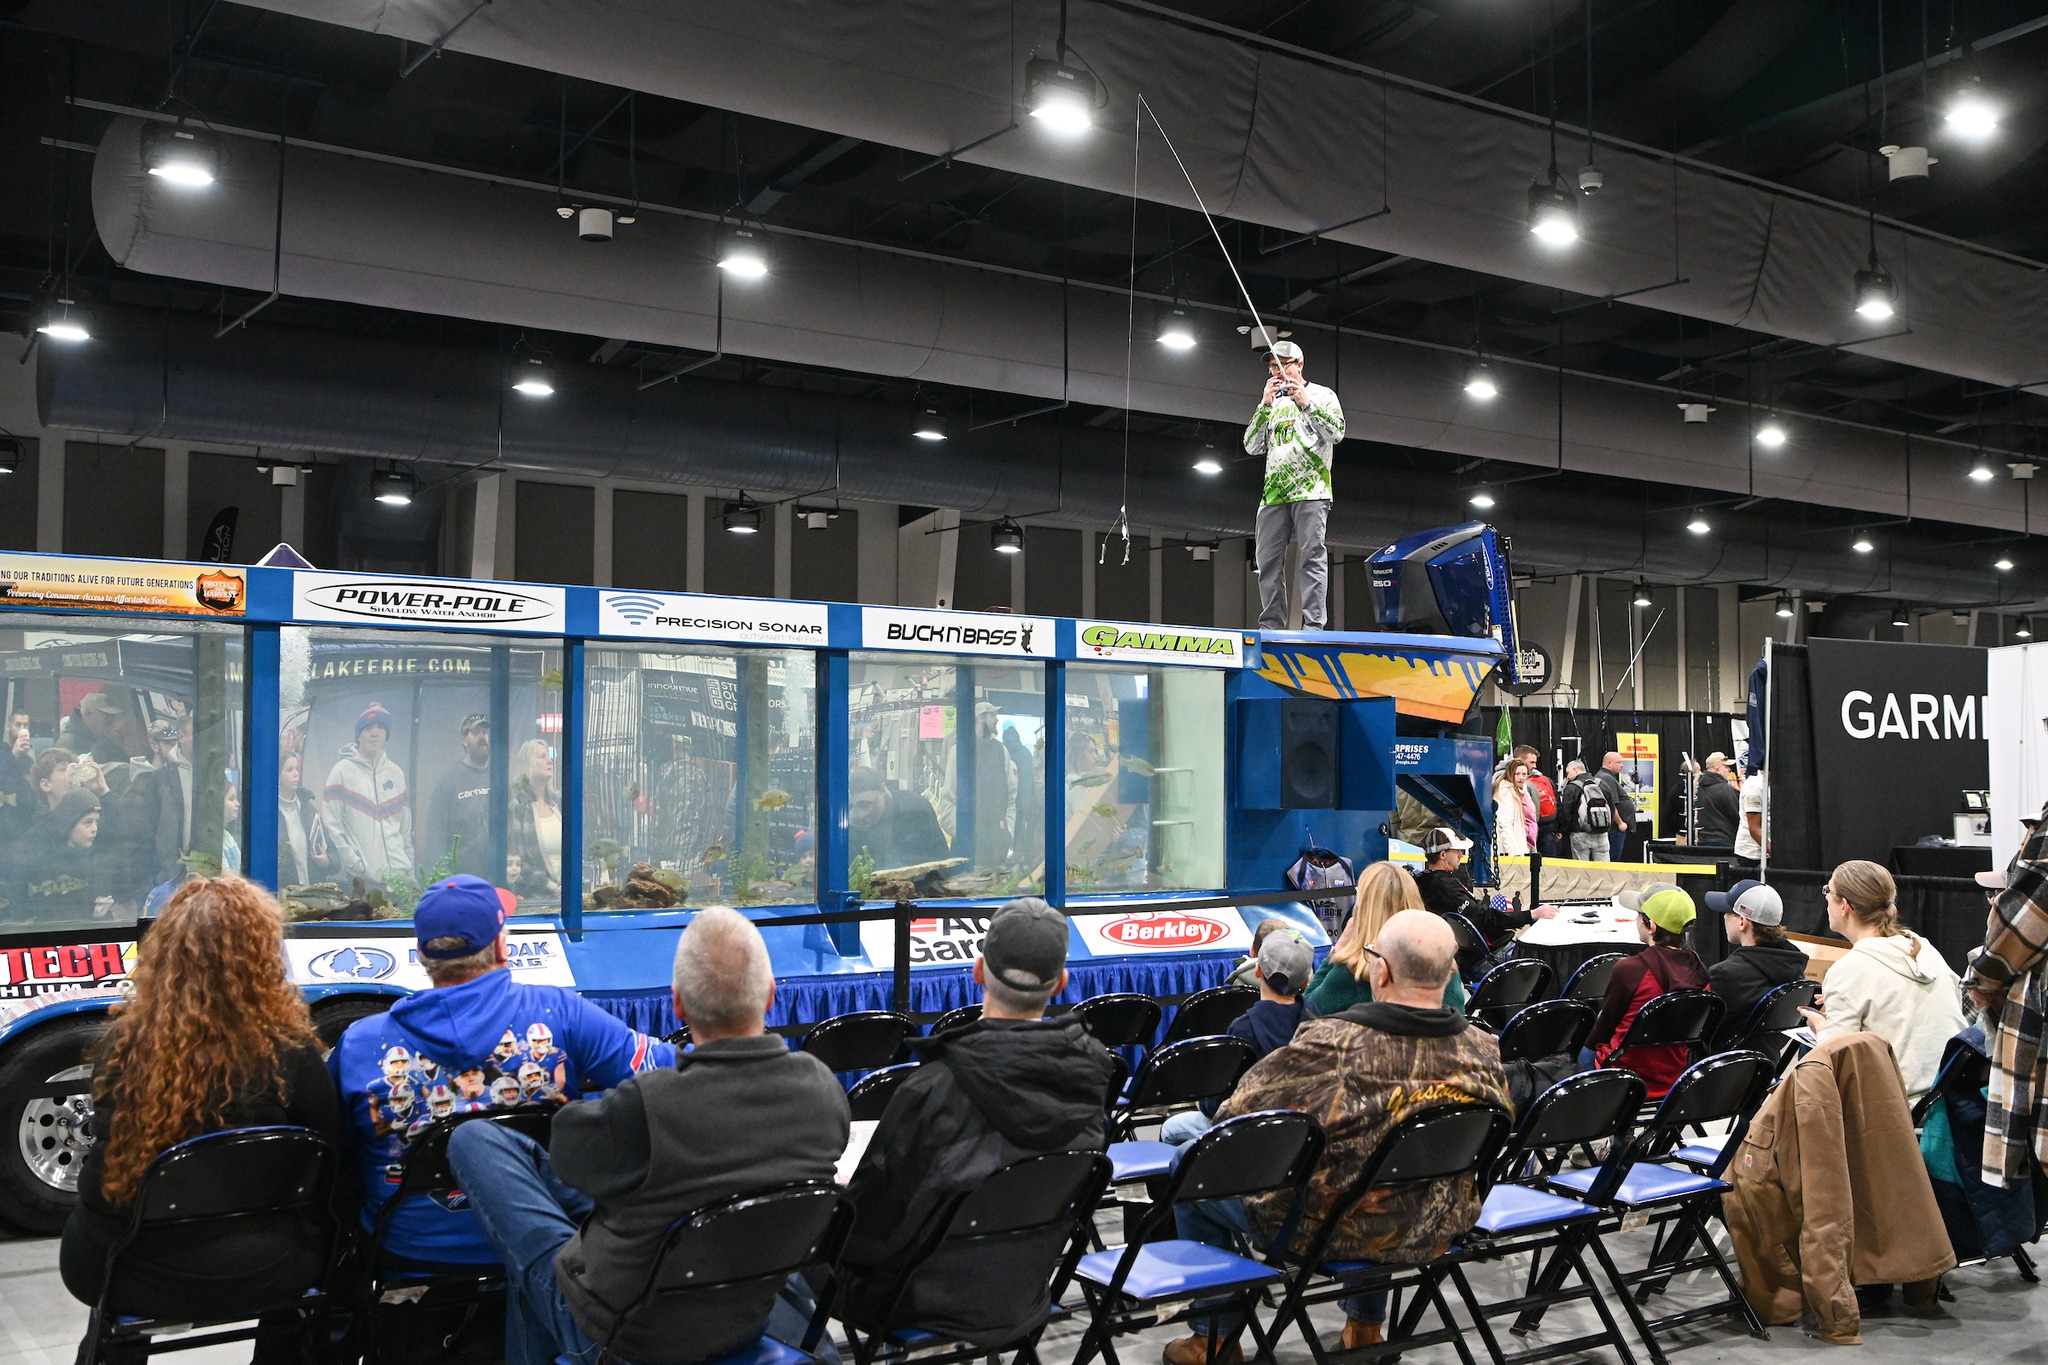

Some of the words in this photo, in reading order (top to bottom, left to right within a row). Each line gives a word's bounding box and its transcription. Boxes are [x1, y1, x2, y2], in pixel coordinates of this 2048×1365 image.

[14, 571, 29, 581] OUR
[32, 572, 75, 583] TRADITIONS
[78, 574, 99, 585] ALIVE
[101, 576, 115, 585] FOR
[117, 577, 144, 587] FUTURE
[147, 578, 194, 590] GENERATIONS
[203, 580, 238, 588] PROTECT
[6, 588, 45, 600] Preserving
[46, 590, 81, 600] Consumer
[82, 592, 105, 602] Access
[105, 594, 113, 602] to
[114, 594, 150, 605] Affordable
[151, 597, 169, 605] Food
[203, 590, 237, 599] HARVEST
[335, 588, 526, 613] POWER-POLE
[656, 616, 753, 631] PRECISION
[758, 622, 823, 635] SONAR
[739, 632, 785, 642] OUTSMART
[788, 635, 803, 643] THE
[805, 636, 823, 644] FISH
[1081, 625, 1234, 656] GAMMA
[1121, 920, 1213, 941] Berkley
